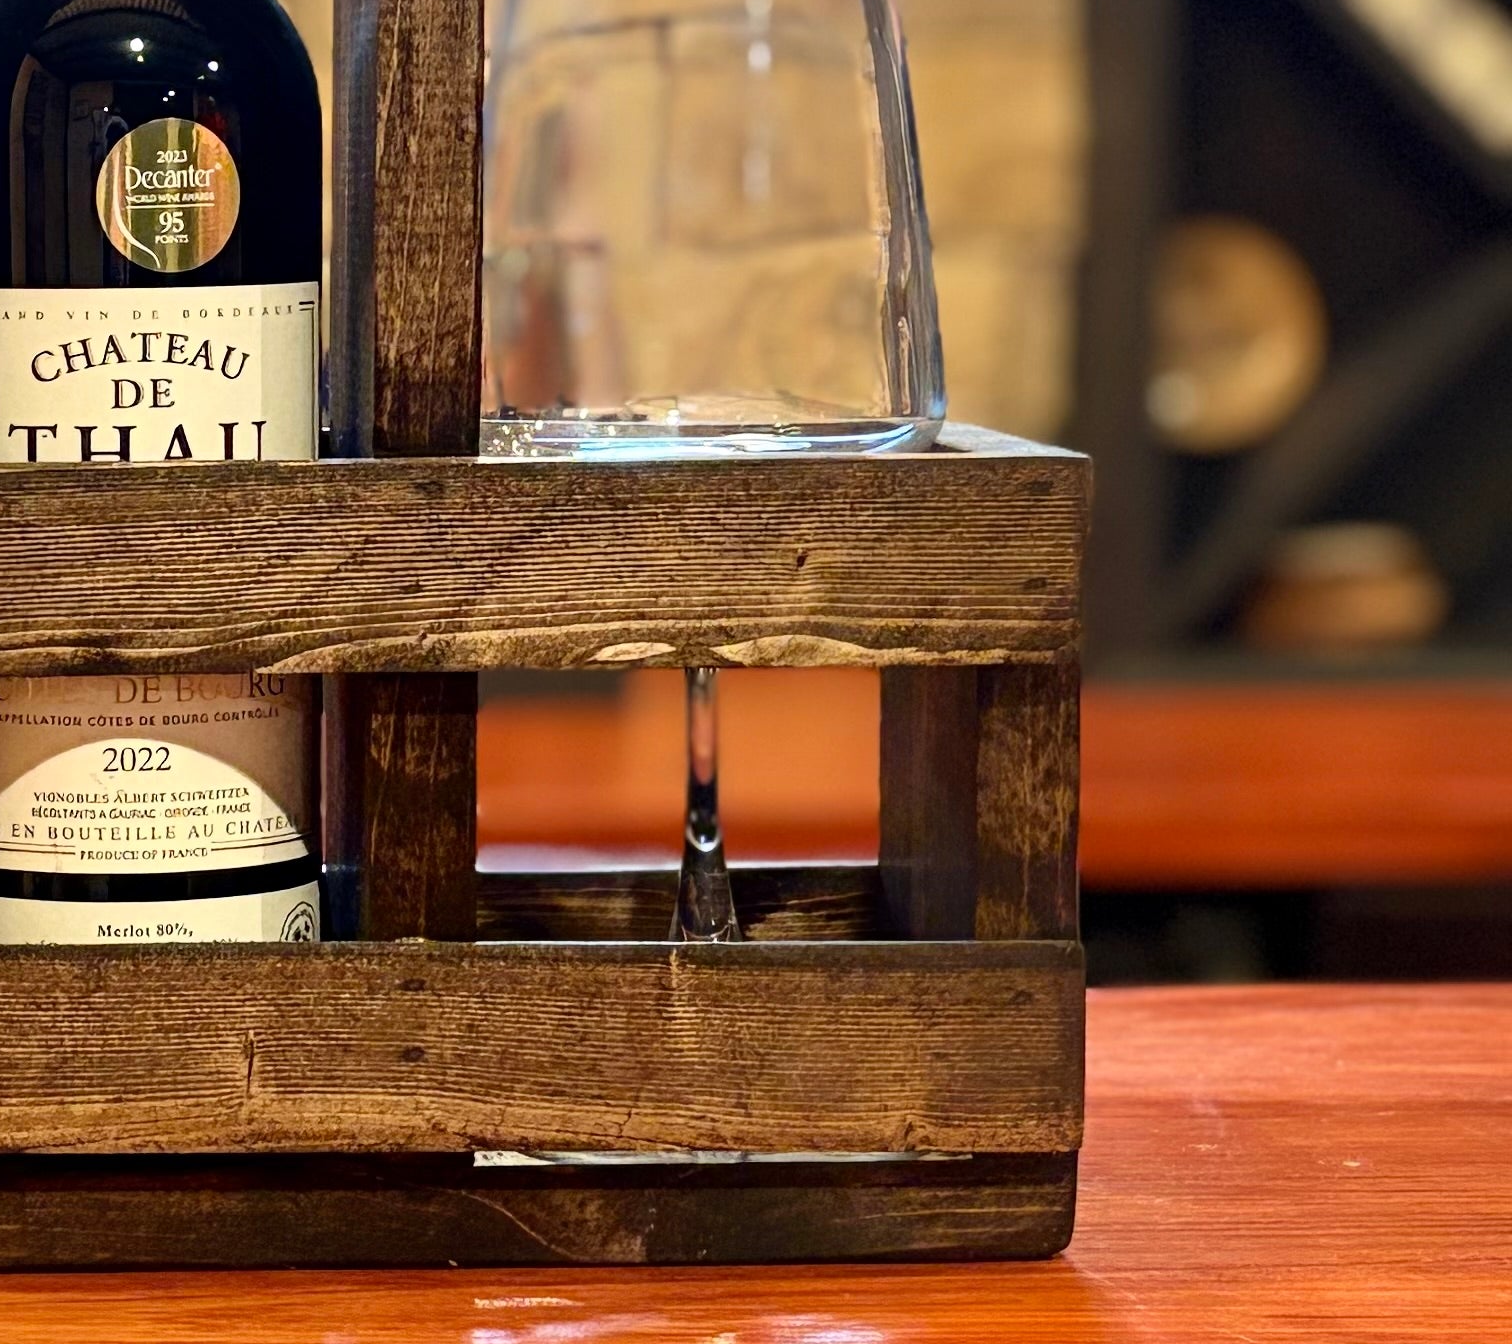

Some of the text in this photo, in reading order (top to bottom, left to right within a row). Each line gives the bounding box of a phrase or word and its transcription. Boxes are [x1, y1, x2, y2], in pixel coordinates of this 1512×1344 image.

[125, 164, 215, 191] Decanter
[158, 211, 185, 234] 95
[66, 311, 109, 320] VIN
[132, 310, 159, 320] DE
[31, 332, 250, 382] CHATEAU
[111, 378, 175, 410] DE
[7, 421, 268, 462] THAU
[116, 674, 163, 704] DE
[139, 714, 156, 726] DE
[102, 747, 172, 772] 2022
[12, 824, 35, 838] EN
[48, 826, 176, 841] BOUTEILLE
[188, 824, 214, 839] AU
[142, 850, 158, 860] OF
[97, 925, 150, 938] Merlot
